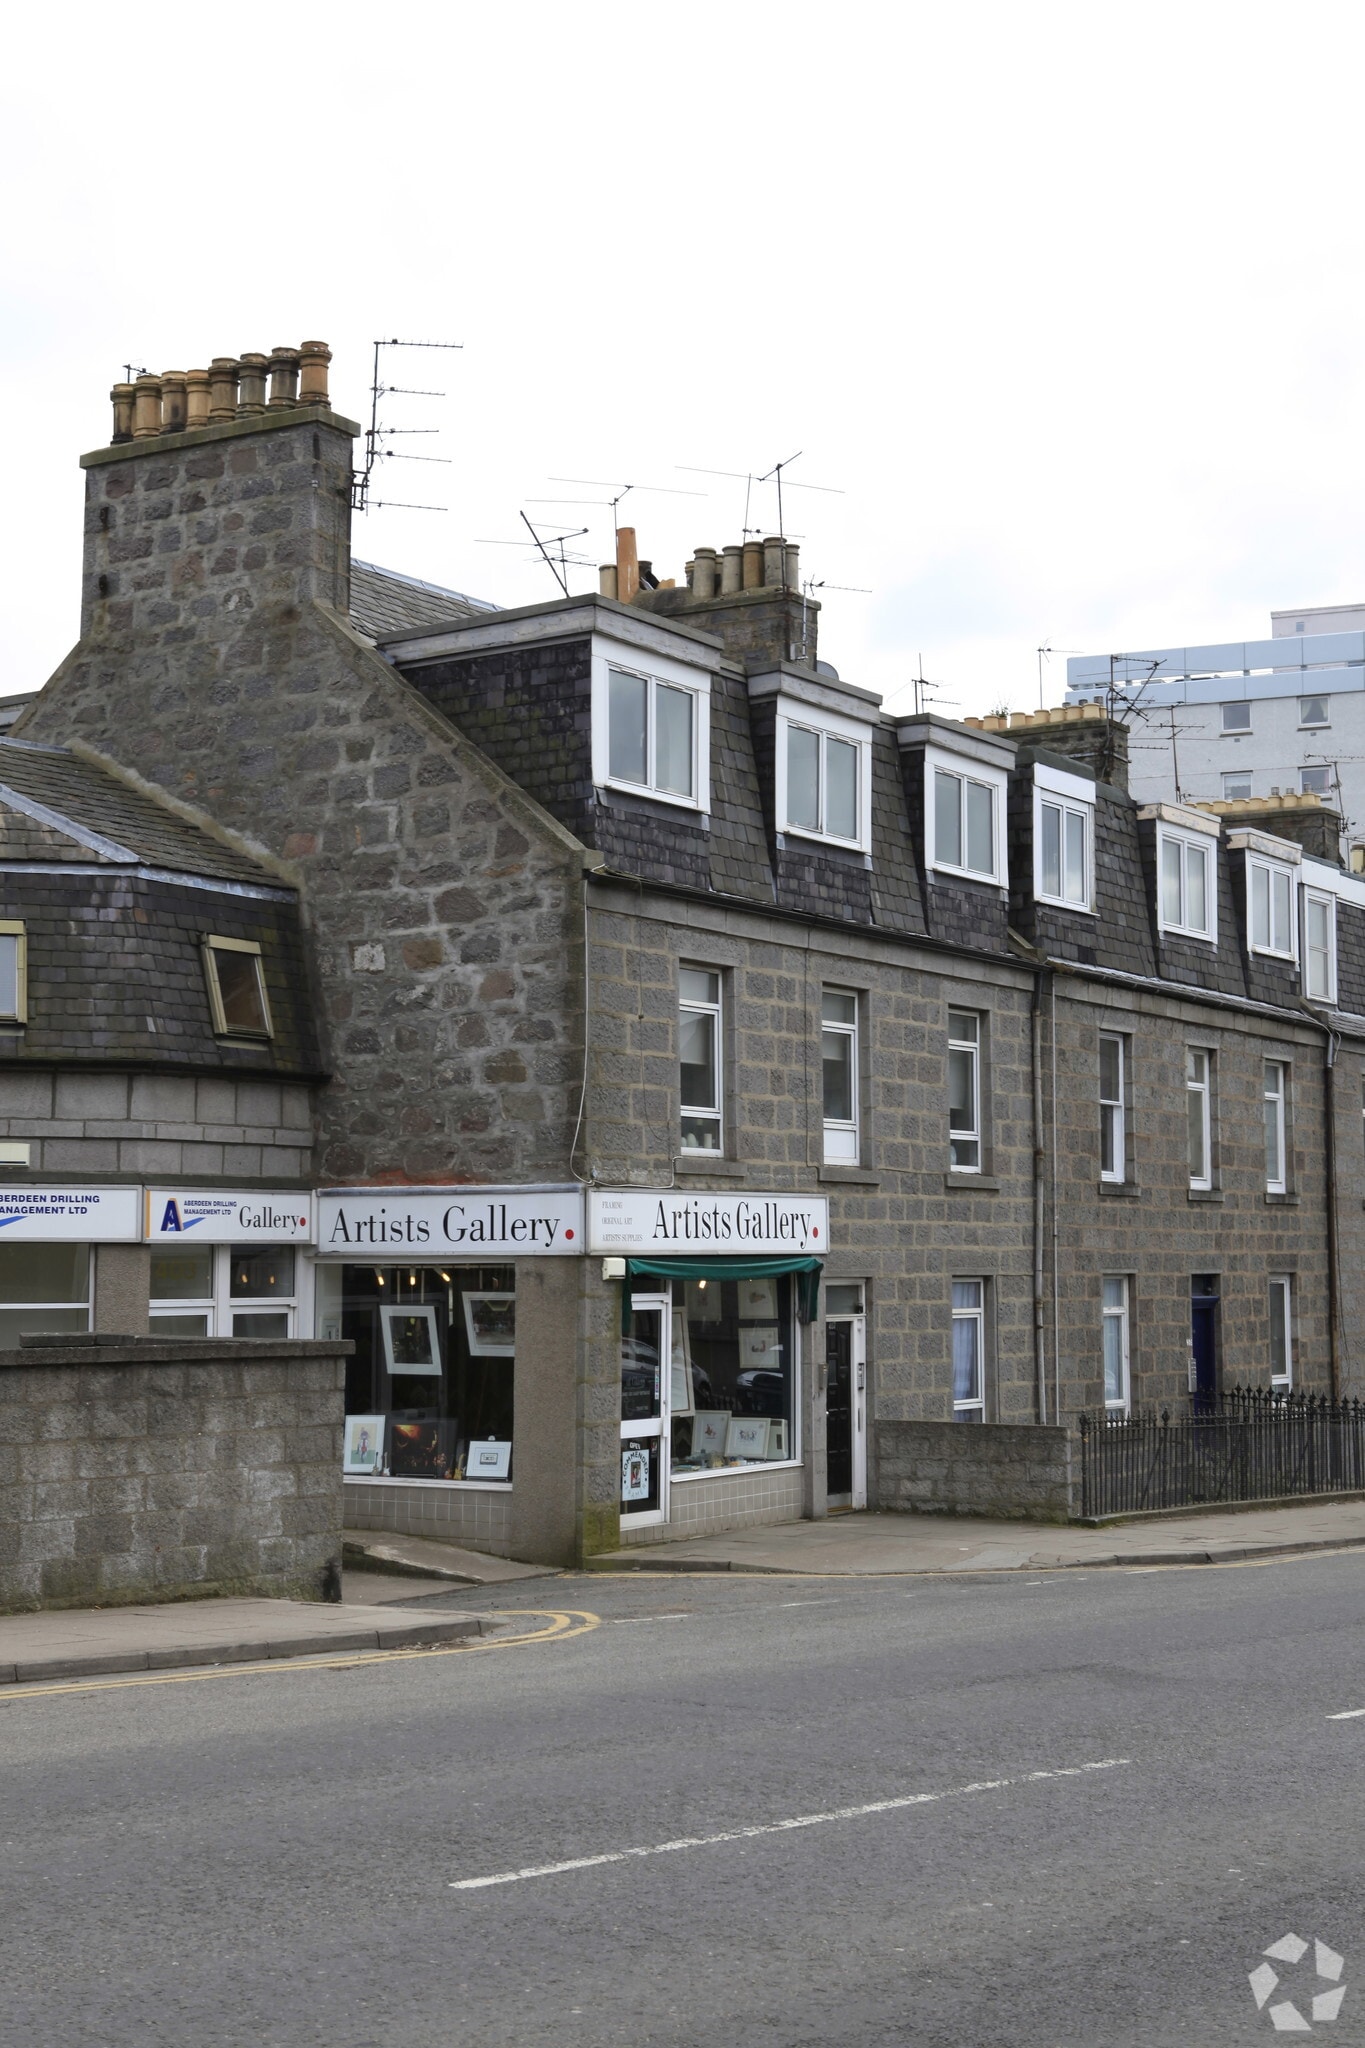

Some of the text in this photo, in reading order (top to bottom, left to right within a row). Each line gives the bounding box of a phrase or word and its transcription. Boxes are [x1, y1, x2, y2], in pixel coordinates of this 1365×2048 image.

[50, 1195, 100, 1203] DRILLING
[68, 1206, 88, 1214] LTD
[652, 1200, 731, 1239] Artists
[328, 1208, 430, 1243] Artists
